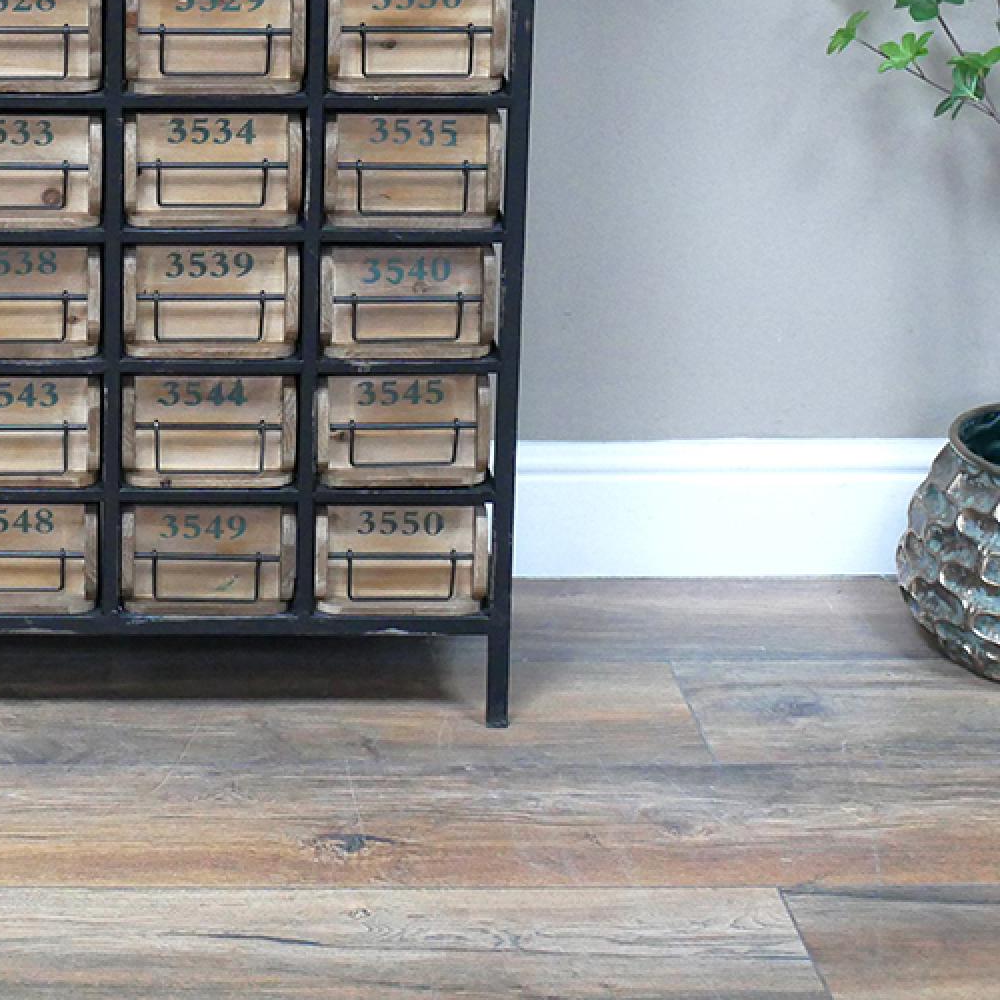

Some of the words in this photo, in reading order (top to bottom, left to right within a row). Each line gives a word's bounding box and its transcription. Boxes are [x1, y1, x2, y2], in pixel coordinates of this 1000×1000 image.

[166, 117, 257, 146] 3534
[369, 118, 458, 146] 3535
[165, 250, 256, 279] 3539
[363, 257, 452, 285] 3540
[157, 379, 247, 407] 3544
[356, 379, 445, 406] 3545
[159, 513, 247, 541] 3549
[357, 509, 445, 536] 3550
